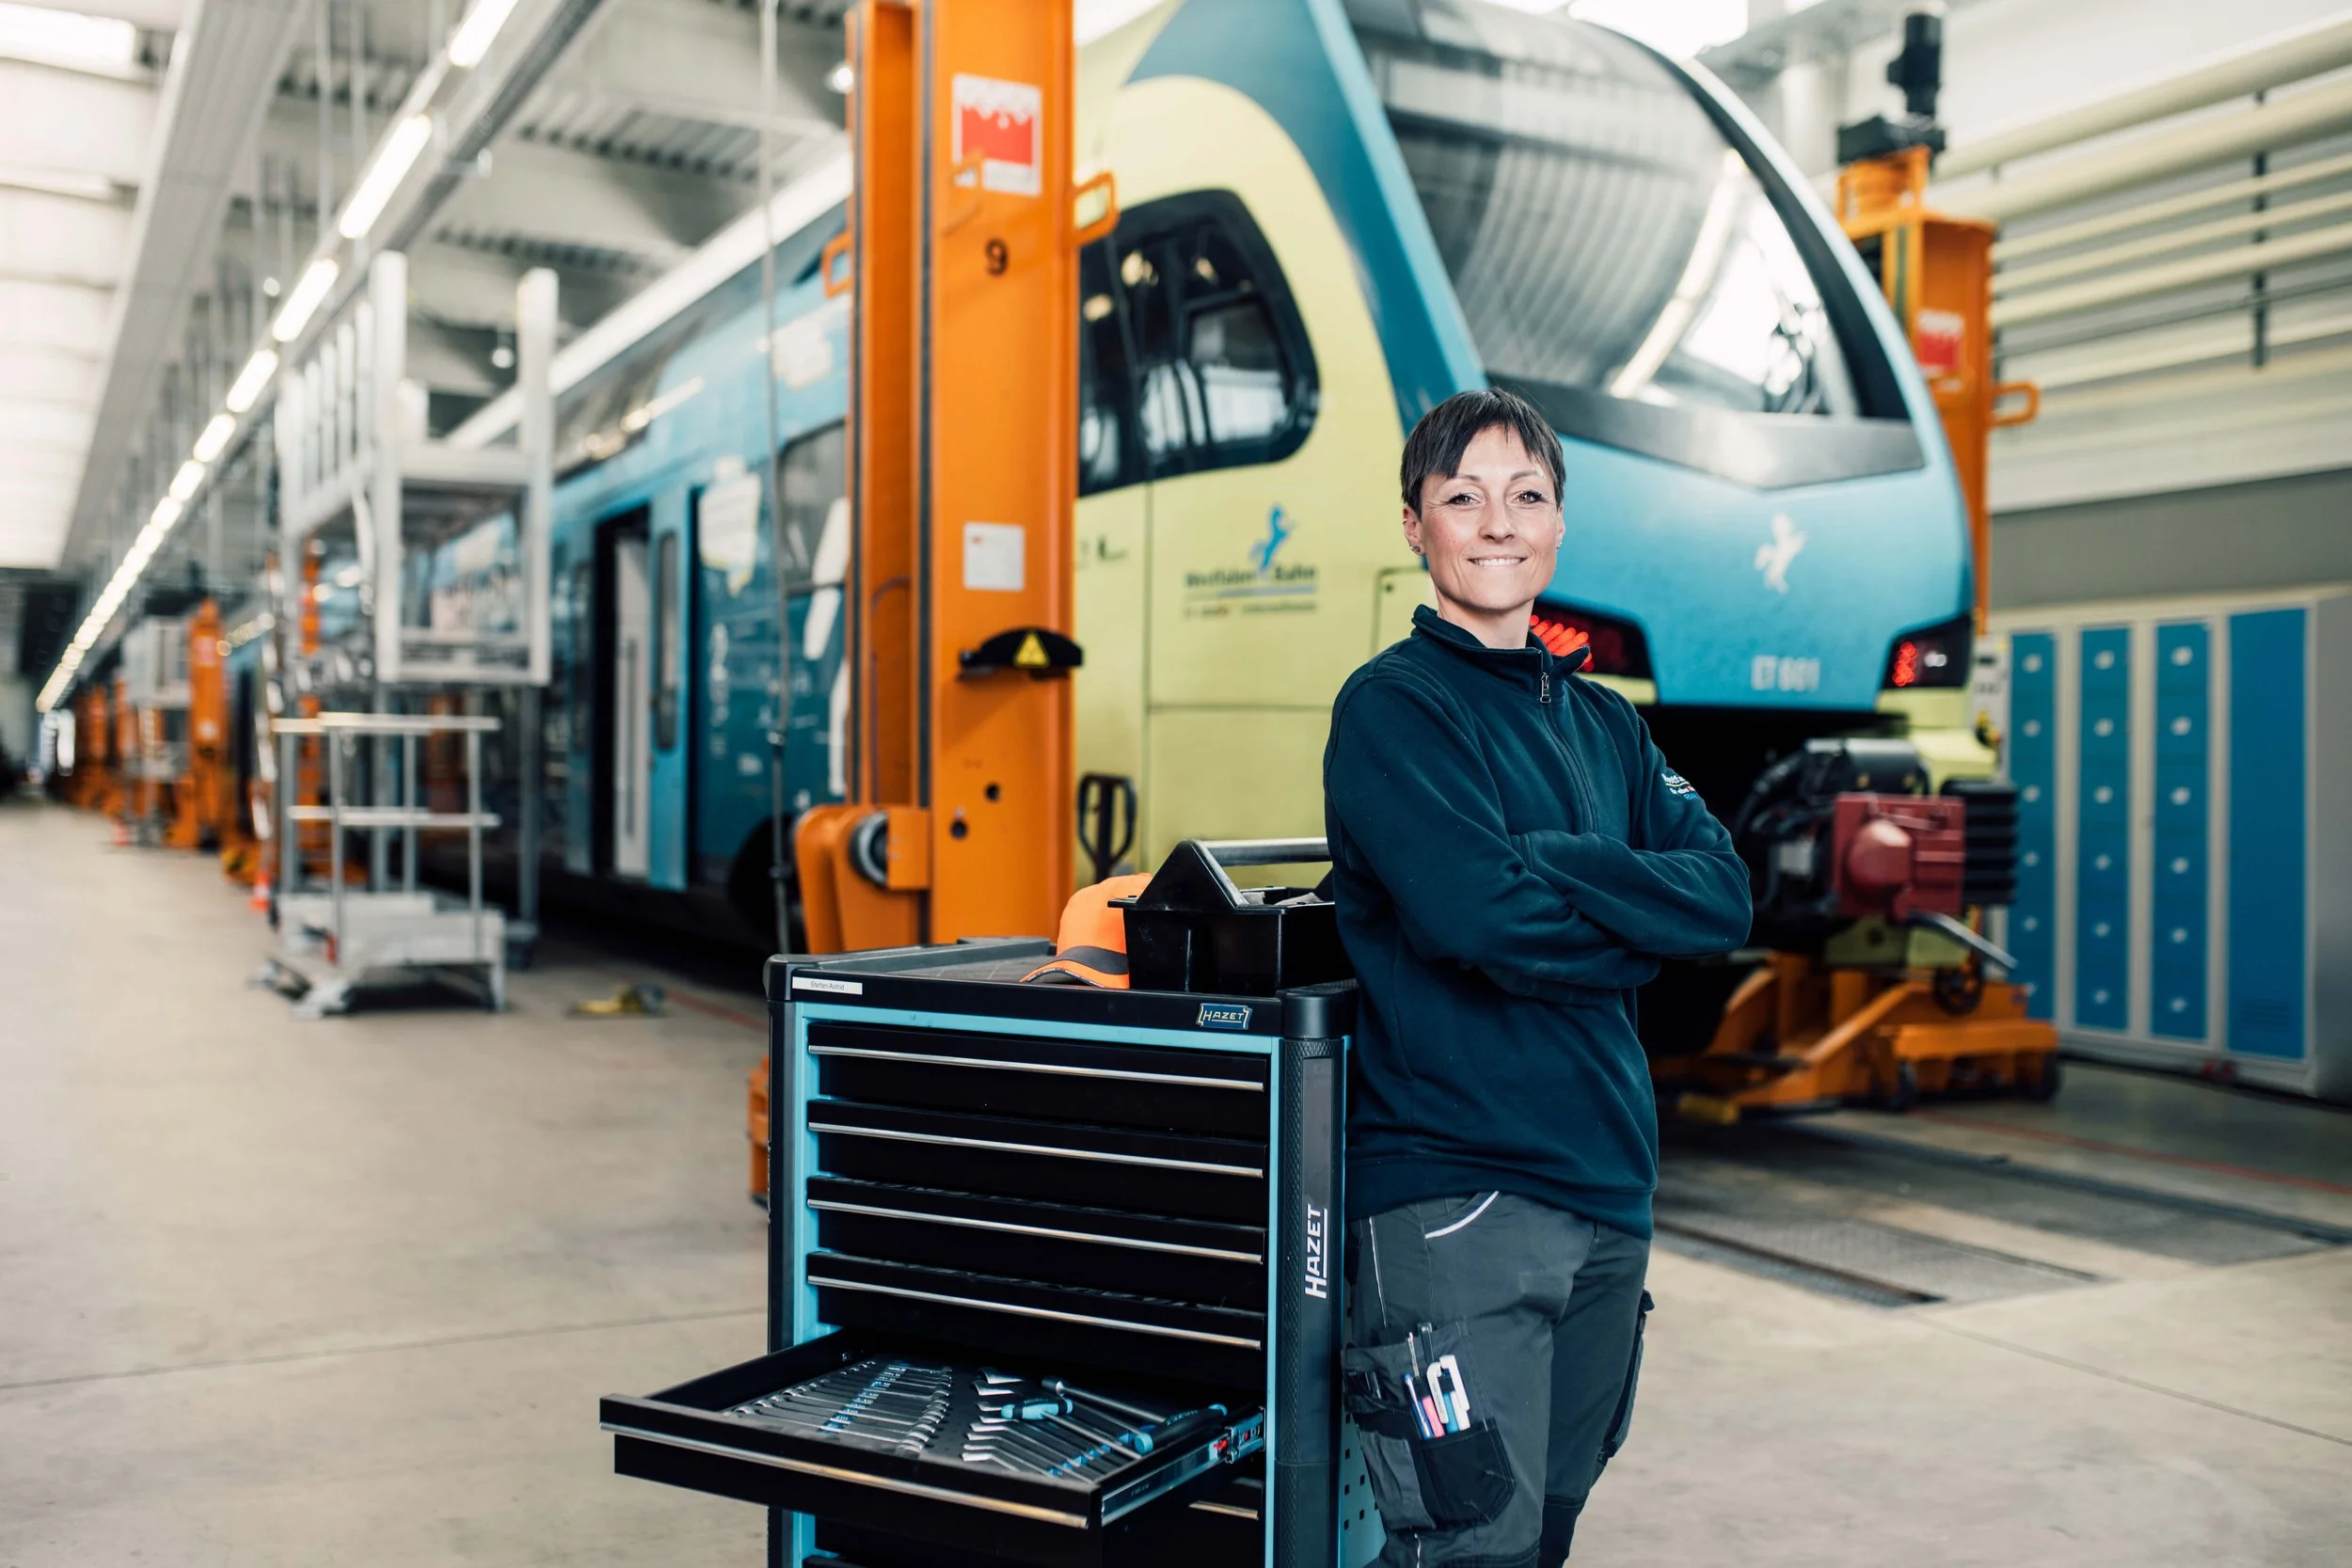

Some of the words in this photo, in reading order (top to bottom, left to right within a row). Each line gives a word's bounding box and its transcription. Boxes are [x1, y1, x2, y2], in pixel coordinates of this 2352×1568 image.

[985, 238, 1008, 276] 9
[1202, 1009, 1244, 1022] HAZET
[1305, 1204, 1327, 1299] HAZET
